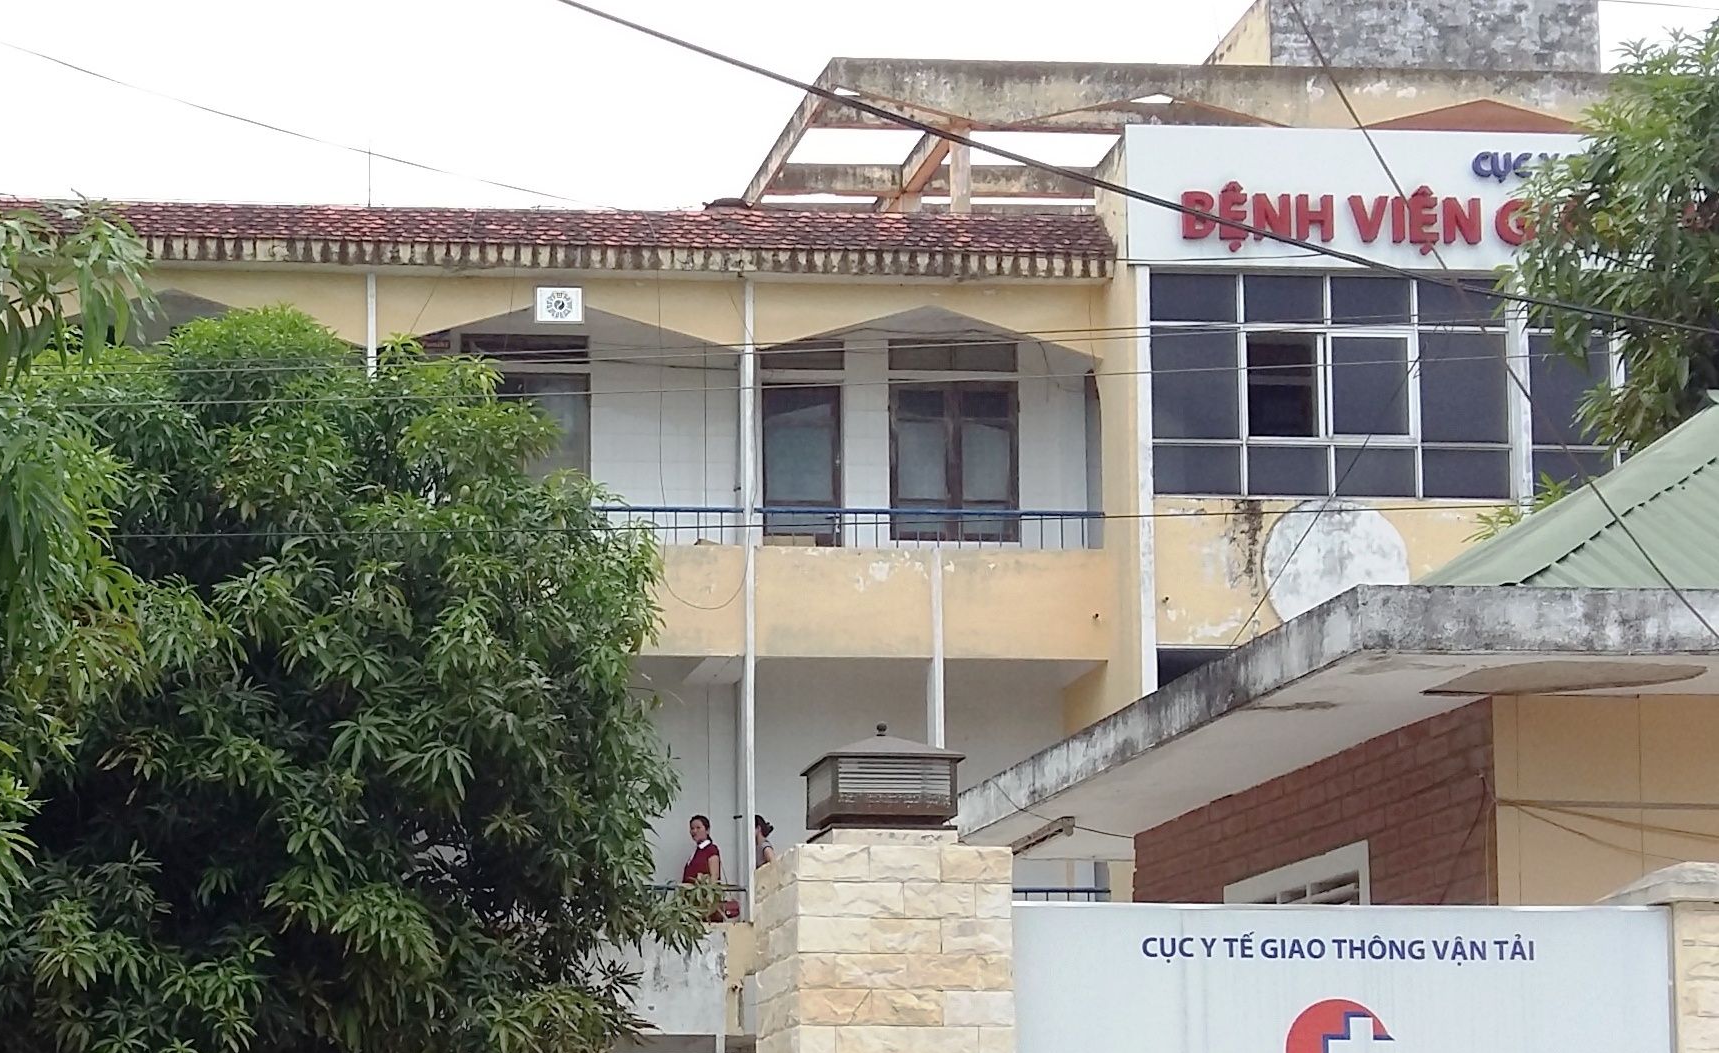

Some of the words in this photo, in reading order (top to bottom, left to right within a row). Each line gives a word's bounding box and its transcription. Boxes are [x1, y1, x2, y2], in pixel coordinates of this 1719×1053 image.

[1181, 181, 1334, 252] BỆNH
[1347, 185, 1482, 256] VIỆN
[1142, 936, 1195, 963] CỤC
[1201, 937, 1218, 958] Y
[1223, 931, 1255, 959] TẾ
[1260, 937, 1327, 960] GIAO
[1332, 932, 1427, 961] THÔNG
[1432, 933, 1488, 967] VẬN
[1494, 933, 1536, 961] TẢI
